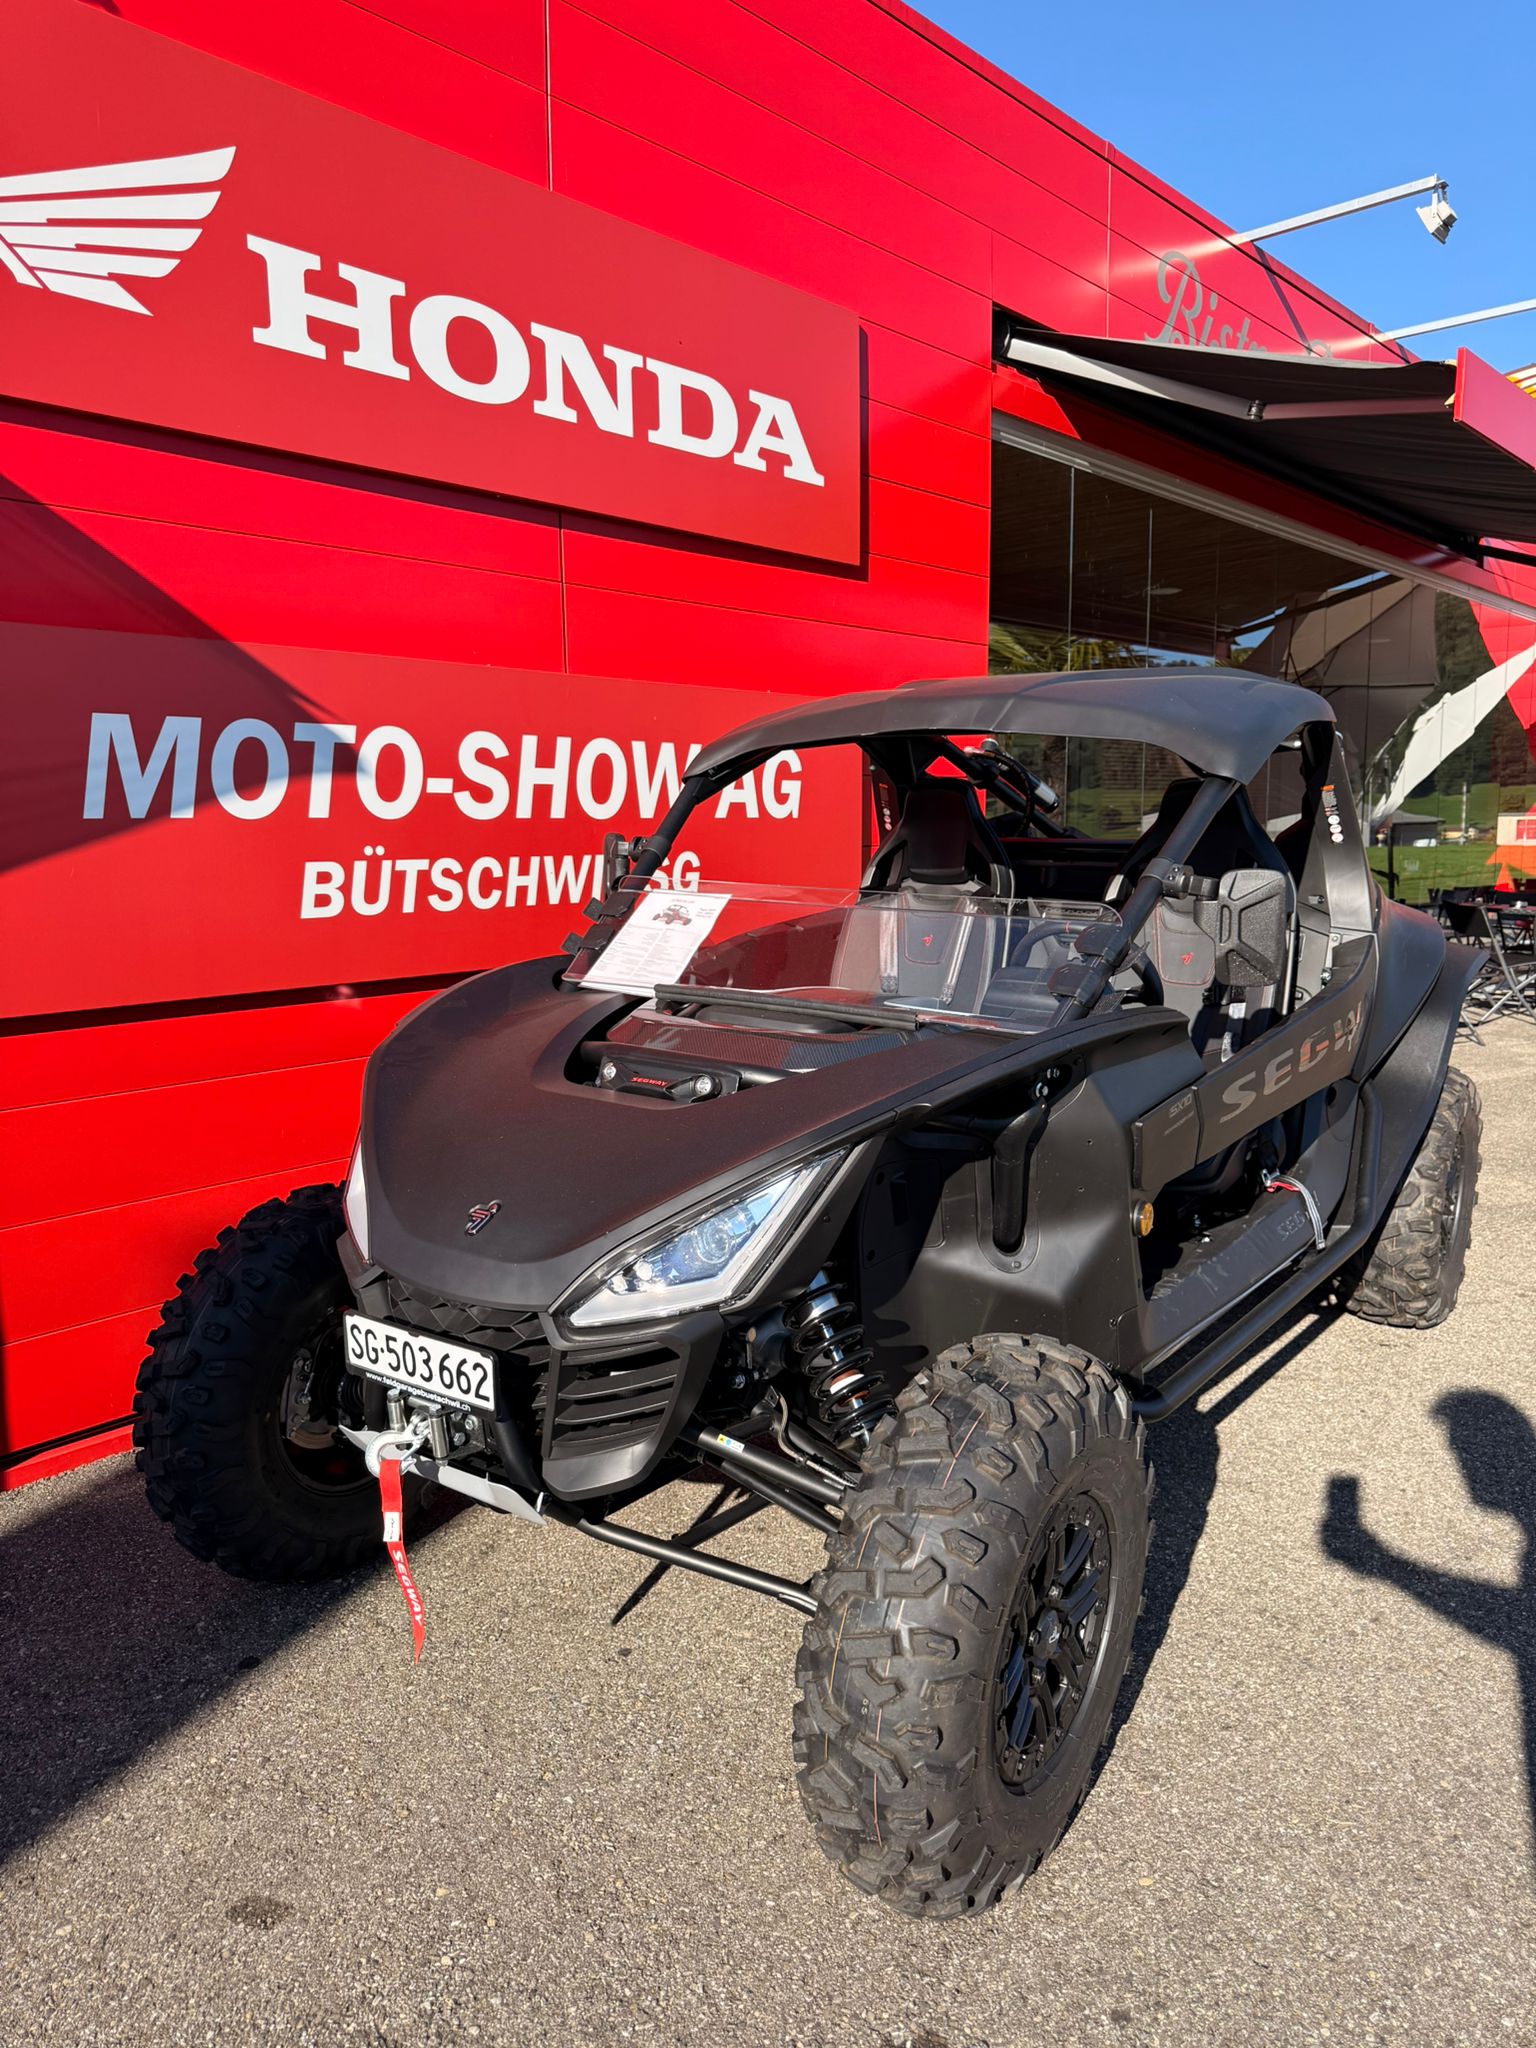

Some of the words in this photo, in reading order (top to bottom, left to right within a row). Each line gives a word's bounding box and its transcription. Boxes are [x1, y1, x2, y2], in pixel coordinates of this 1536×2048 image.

[246, 233, 825, 488] HONDA
[83, 712, 703, 821] MOTO-SHOW
[714, 748, 803, 820] AG
[300, 844, 605, 920] BÜTSCHWI
[630, 1076, 669, 1088] SEGWAY
[392, 1549, 423, 1627] SEGWAY
